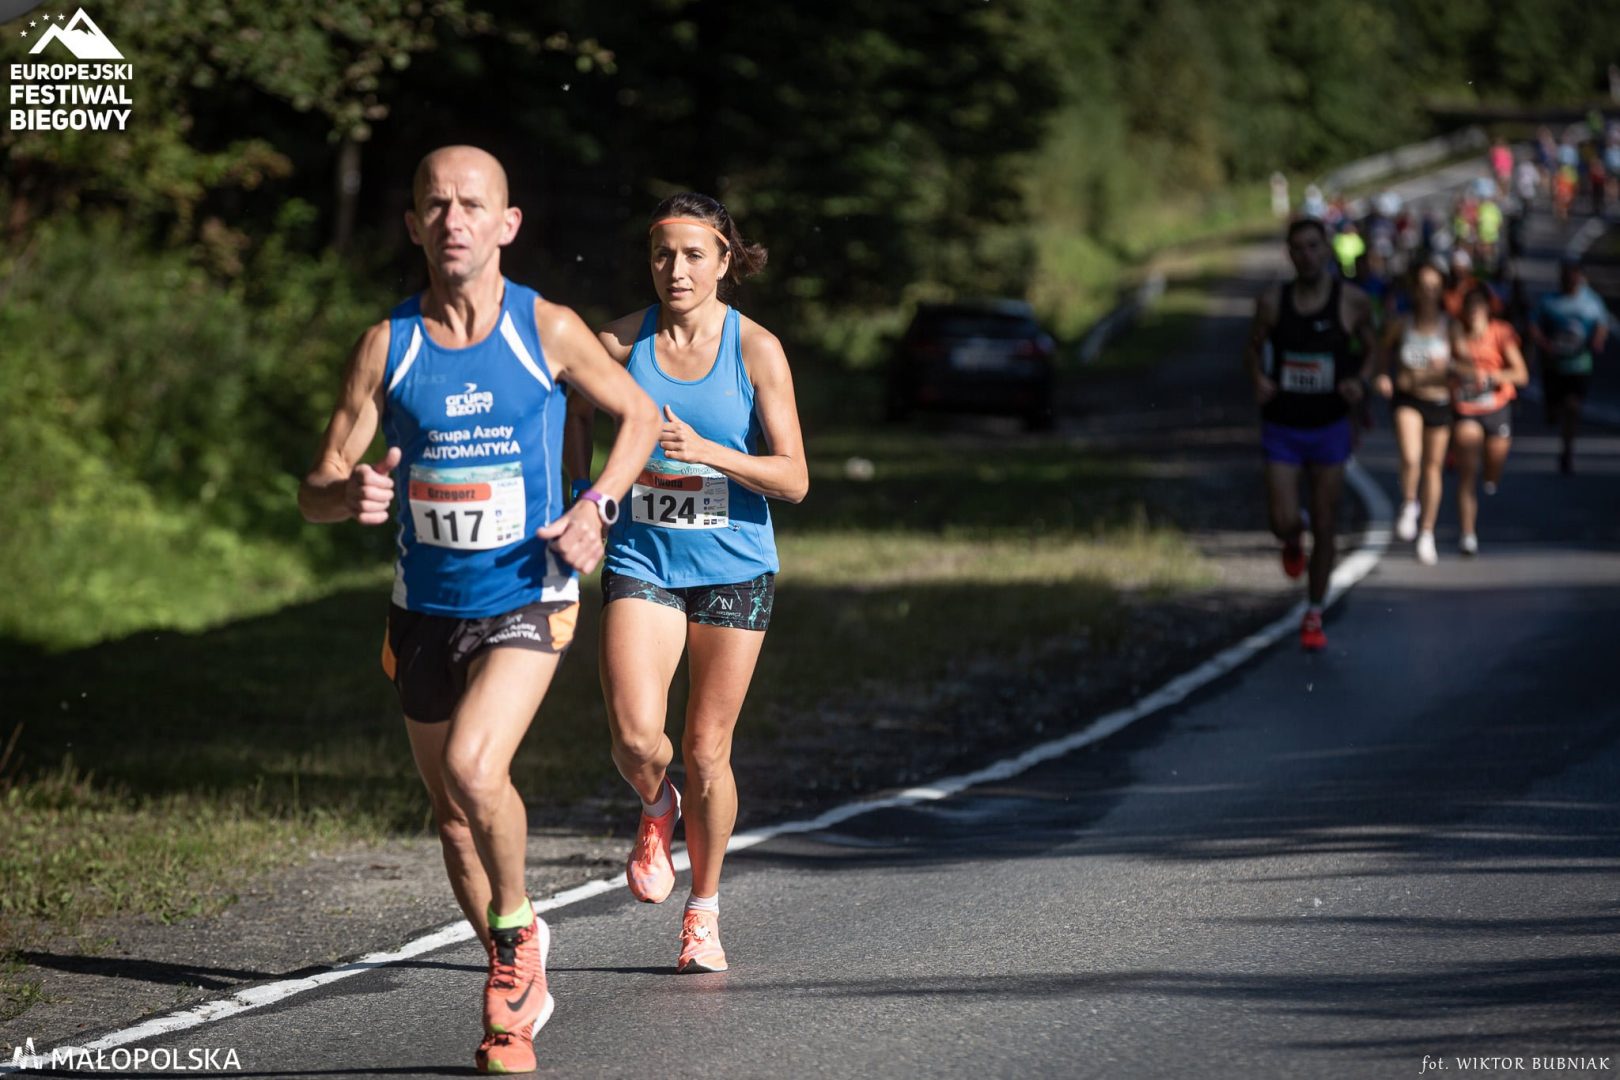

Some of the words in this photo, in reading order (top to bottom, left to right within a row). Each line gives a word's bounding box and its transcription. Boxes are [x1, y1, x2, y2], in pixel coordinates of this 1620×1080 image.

[428, 430, 470, 443] Grupa
[473, 425, 514, 440] Azoty
[423, 440, 521, 459] AUTOMATYKA
[642, 493, 697, 525] 124
[424, 508, 484, 543] 117
